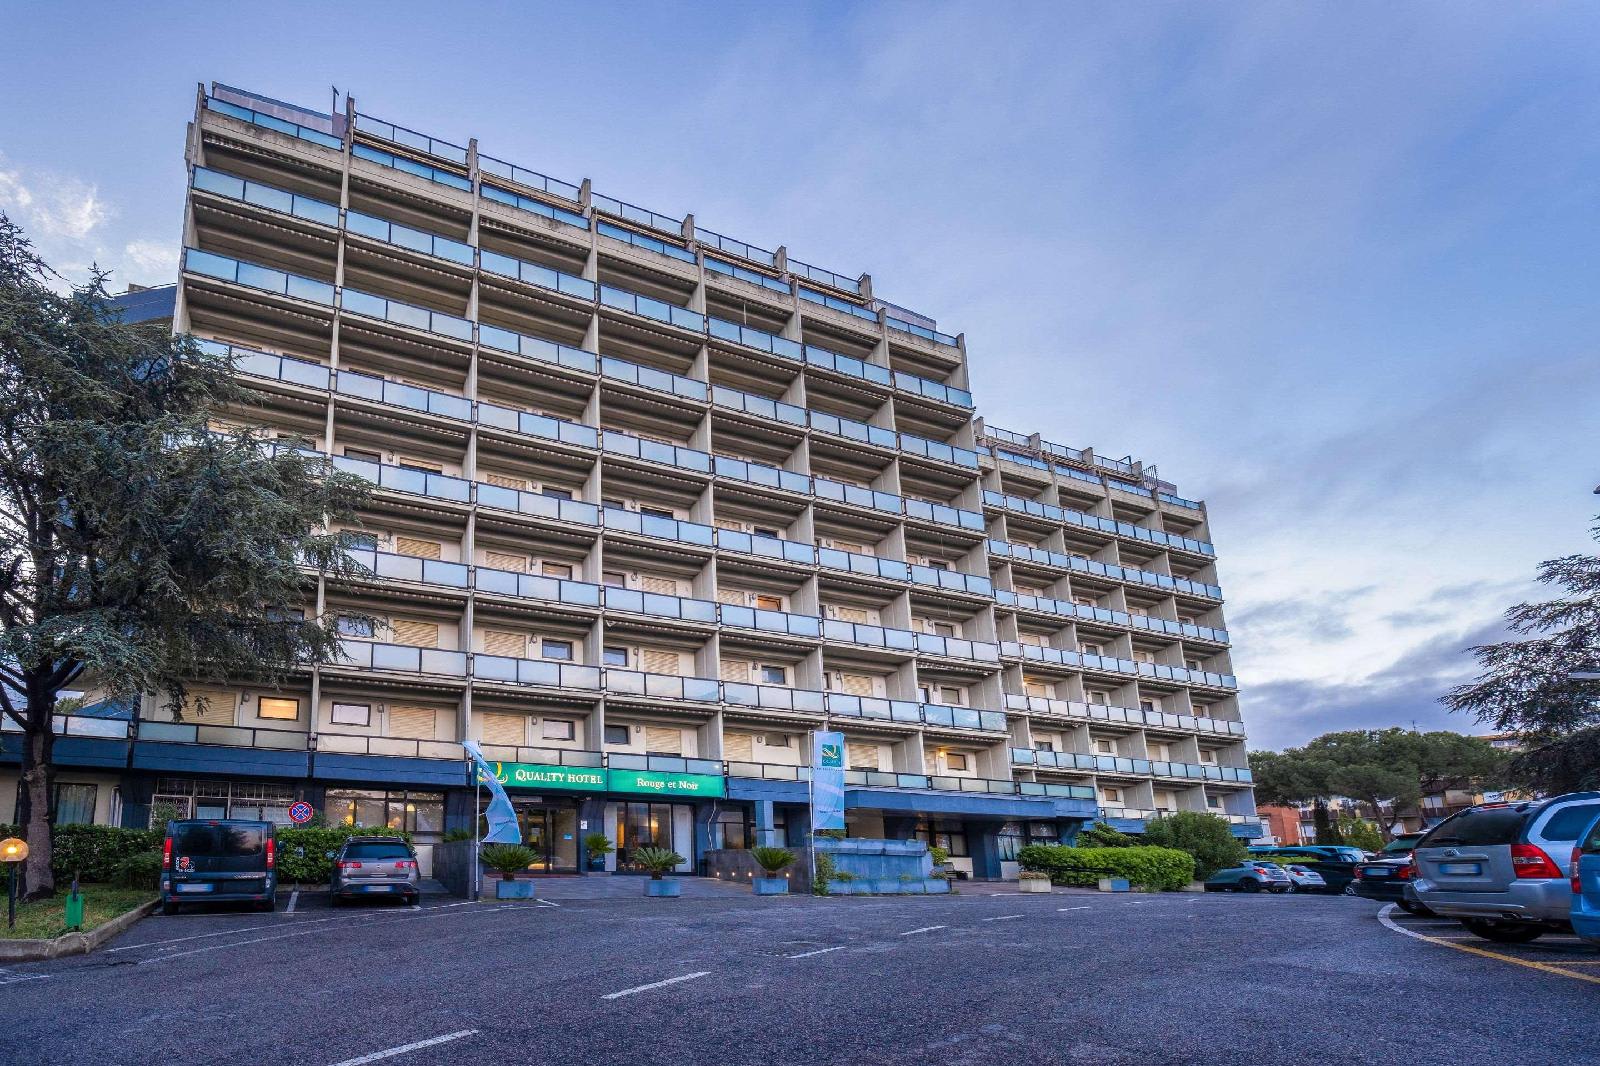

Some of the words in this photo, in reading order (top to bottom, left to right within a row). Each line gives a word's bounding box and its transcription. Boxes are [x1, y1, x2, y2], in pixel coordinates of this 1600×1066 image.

[515, 769, 564, 782] QUALITY
[567, 773, 603, 784] HOTEL
[636, 778, 665, 790] Rouge
[667, 780, 676, 789] et
[678, 780, 699, 790] Noir
